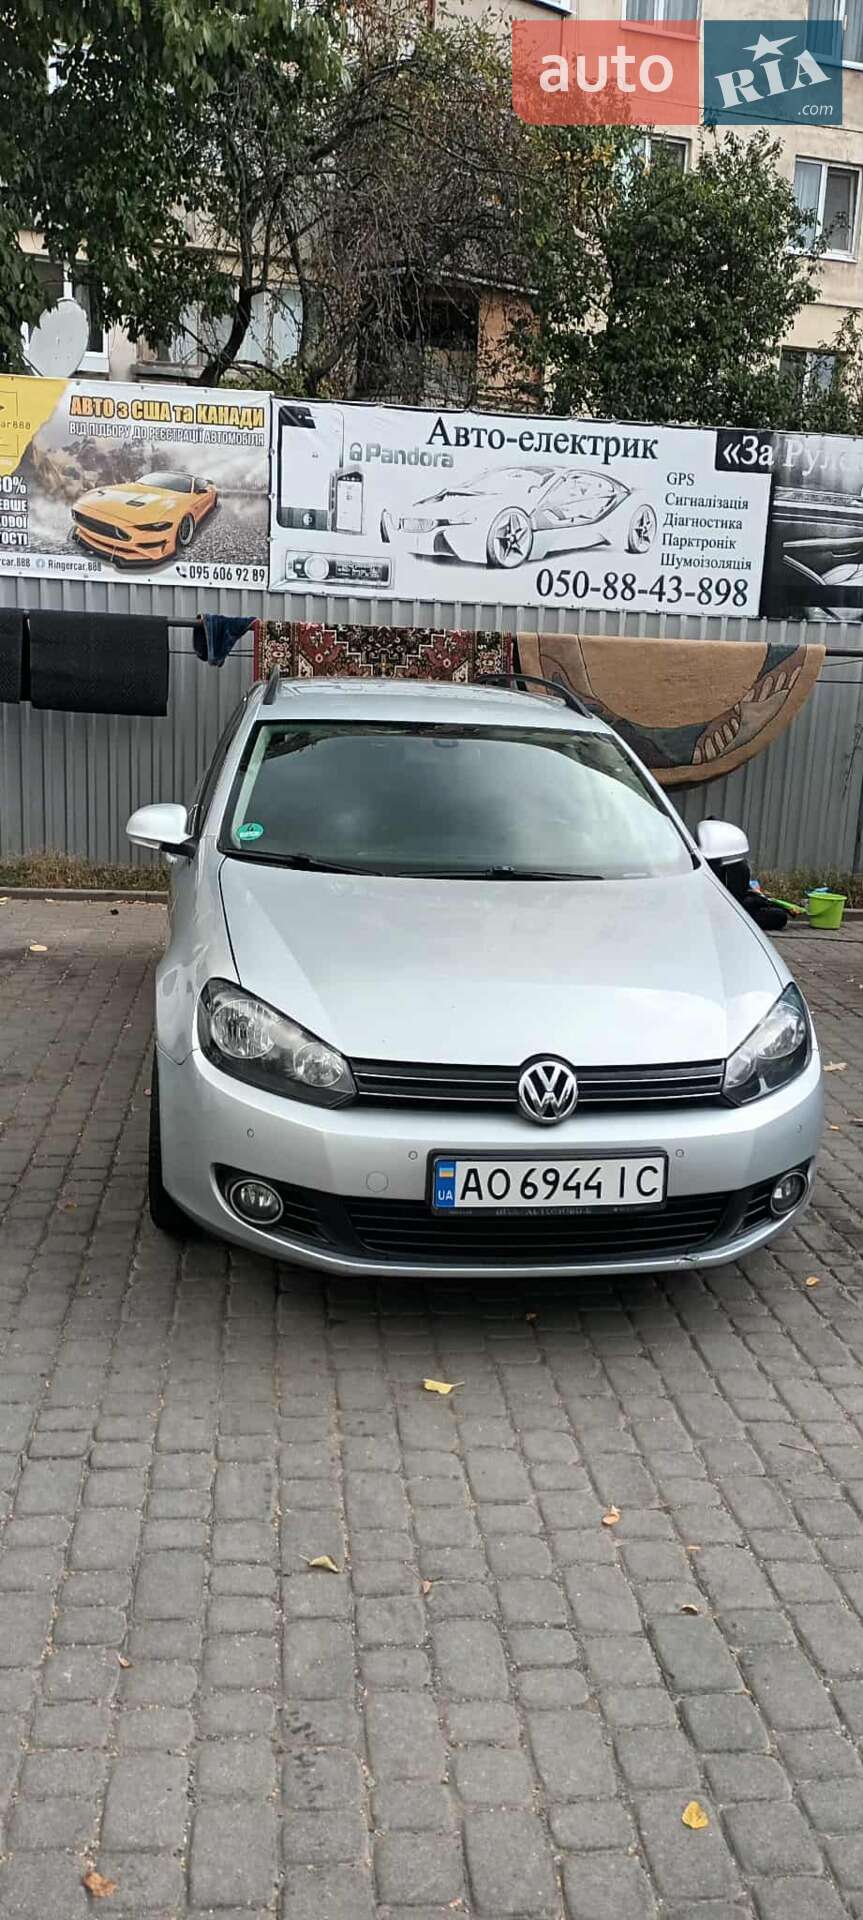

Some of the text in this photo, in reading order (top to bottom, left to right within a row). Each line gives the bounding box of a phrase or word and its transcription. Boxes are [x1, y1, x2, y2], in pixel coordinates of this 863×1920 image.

[69, 395, 265, 429] АВТО з США та КАНАДИ
[69, 421, 87, 435] ВІД
[88, 423, 131, 438] ПІДБОРУ
[426, 416, 659, 465] Авто-електрик
[365, 443, 454, 468] Pandora
[722, 435, 775, 467] «За
[667, 472, 695, 486] GPS
[665, 494, 749, 510] Сигналізація
[663, 513, 743, 531] Діагностика
[662, 533, 736, 550] Парктронік
[660, 553, 752, 571] Шумоізоляція
[189, 565, 265, 583] 095 606 92 89
[536, 568, 749, 607] 050-88-43-898
[460, 1165, 659, 1201] AO 6944 IC
[438, 1190, 454, 1201] UA
